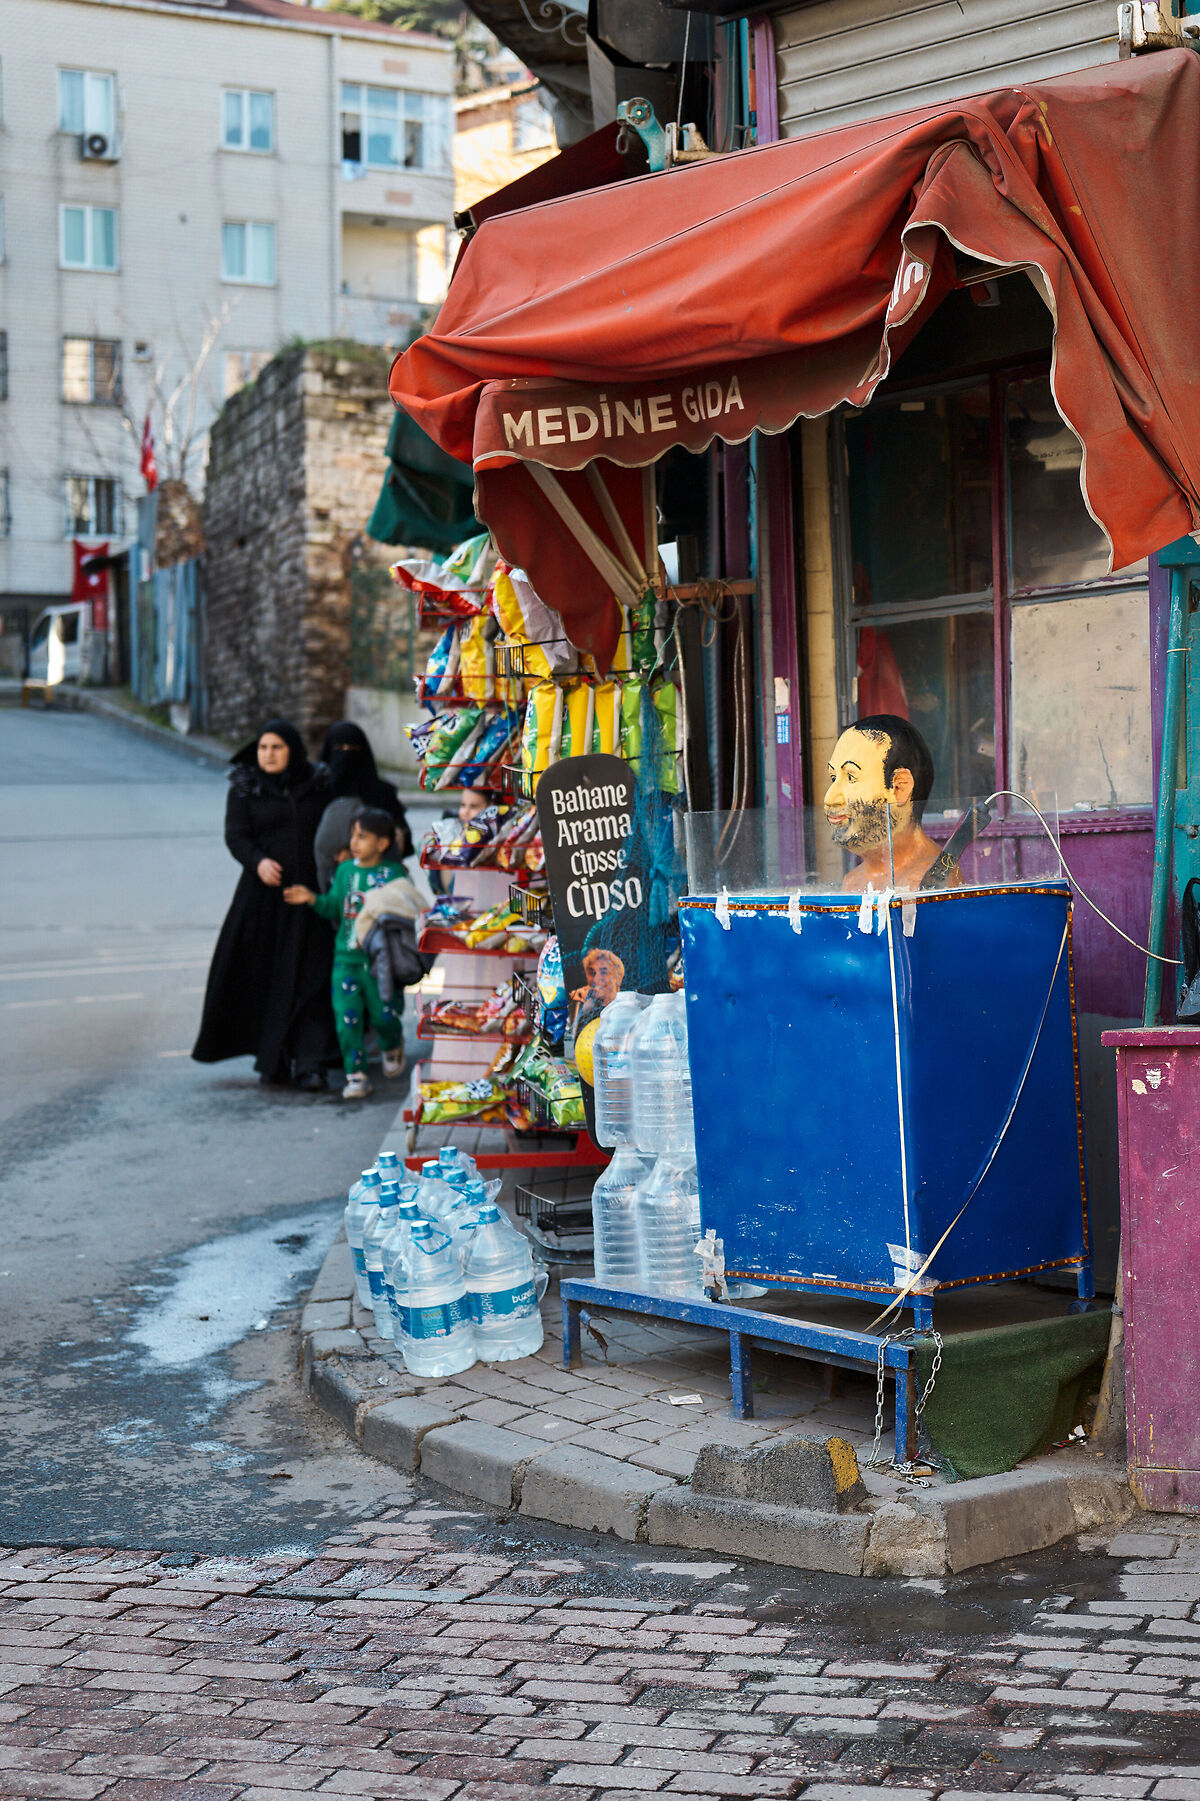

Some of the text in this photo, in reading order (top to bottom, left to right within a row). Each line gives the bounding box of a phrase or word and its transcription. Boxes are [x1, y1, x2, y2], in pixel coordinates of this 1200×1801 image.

[502, 375, 745, 449] MEDİNE GIDA
[551, 783, 628, 815] Bahane
[557, 813, 633, 847] Arama
